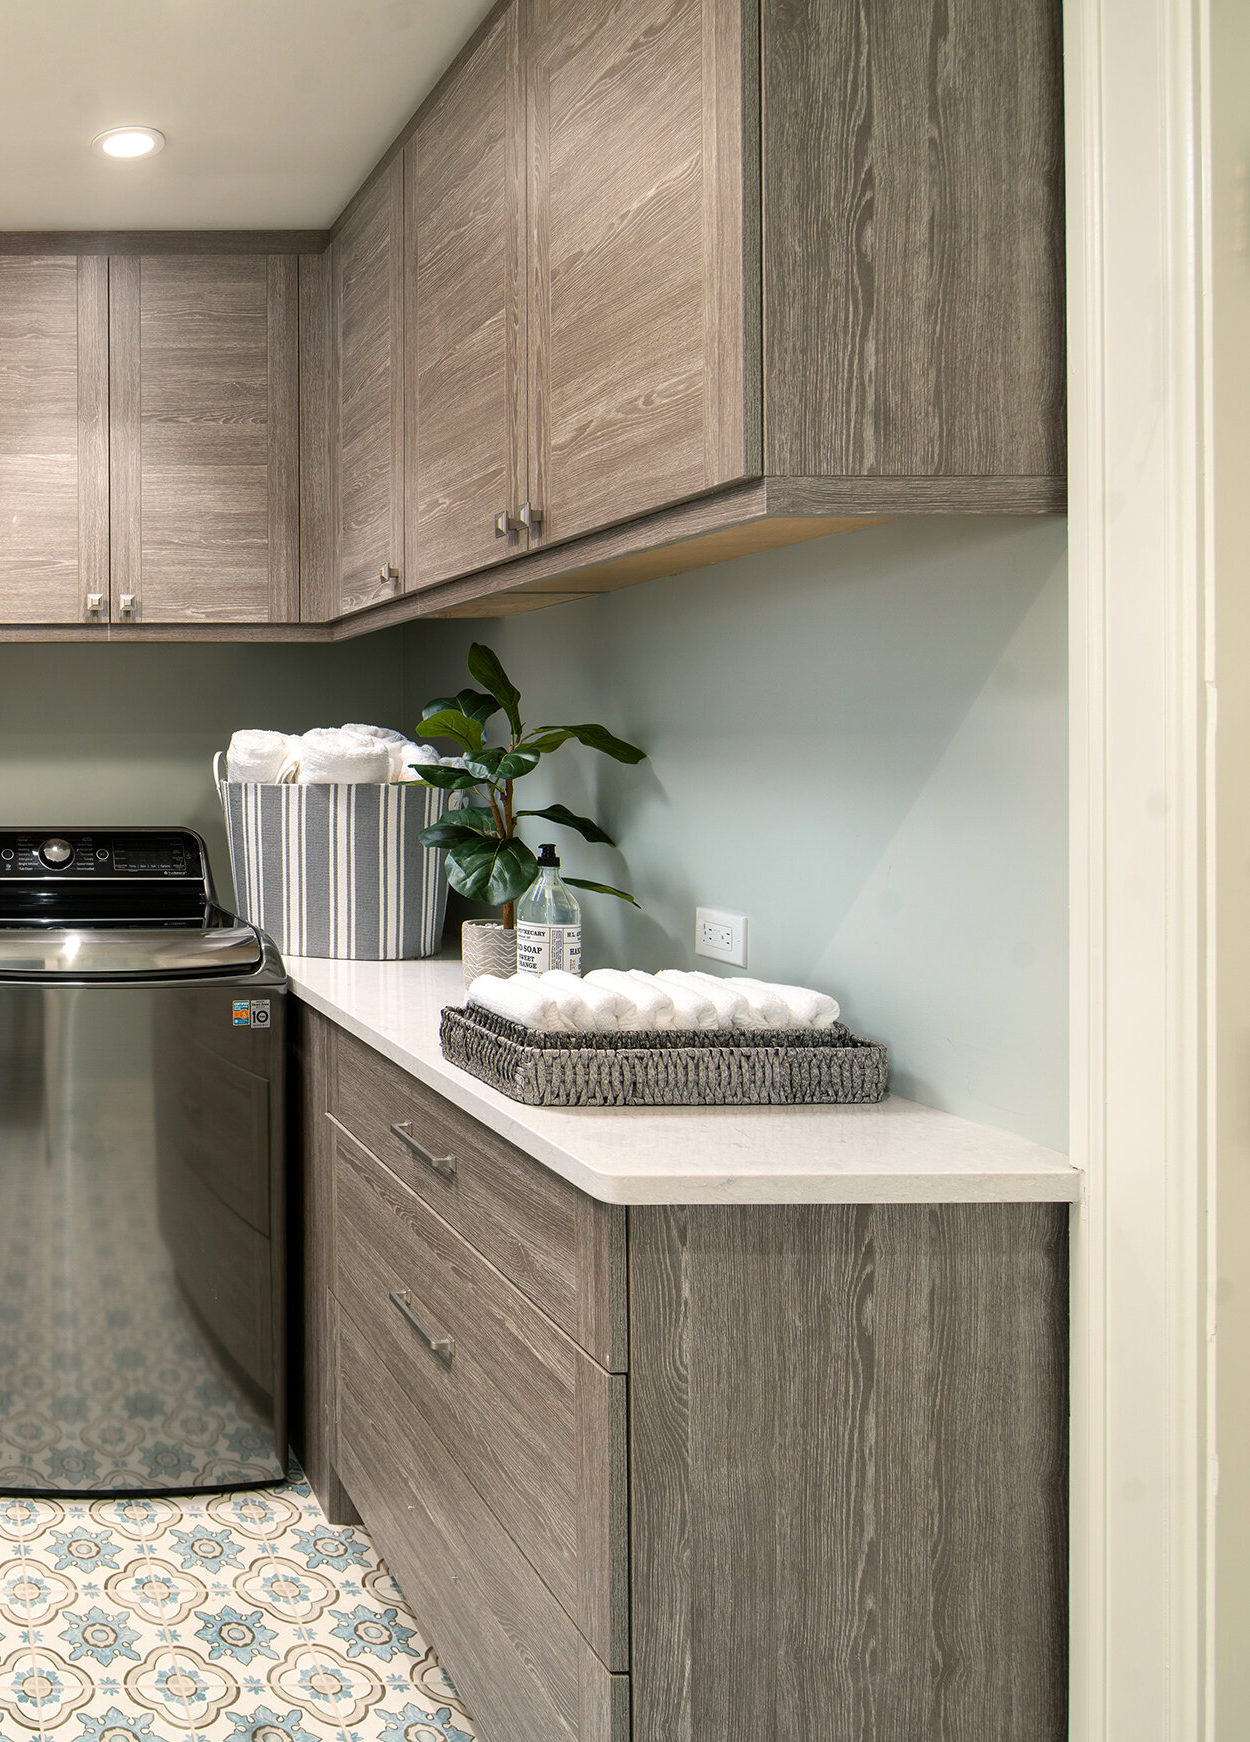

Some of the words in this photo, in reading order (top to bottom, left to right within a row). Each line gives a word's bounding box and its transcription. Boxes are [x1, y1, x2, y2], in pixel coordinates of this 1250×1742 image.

[523, 945, 543, 954] SOAP
[518, 960, 537, 969] RANGE
[252, 1010, 269, 1023] 10
